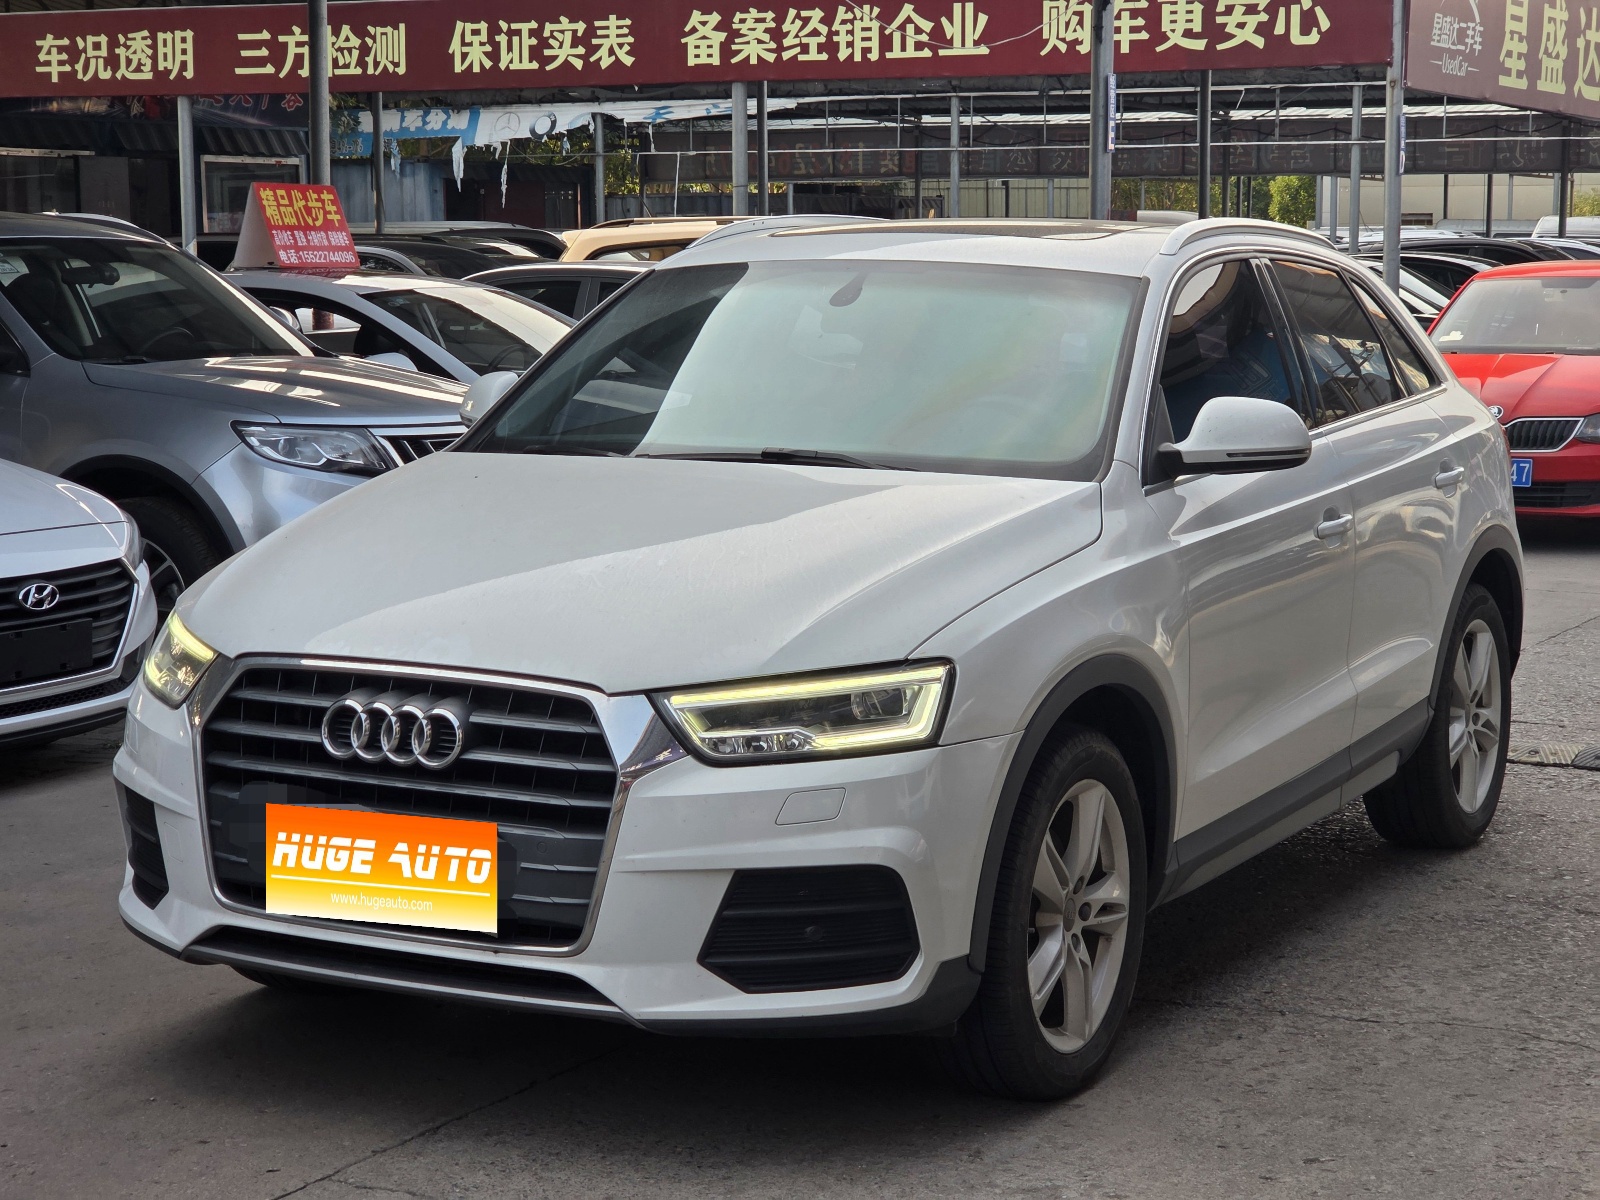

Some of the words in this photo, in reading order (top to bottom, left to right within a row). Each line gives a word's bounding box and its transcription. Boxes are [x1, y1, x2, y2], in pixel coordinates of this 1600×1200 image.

[35, 29, 195, 83] 车况透明
[234, 23, 407, 79] 三方检测
[448, 14, 636, 73] 保证实表
[680, 2, 991, 66] 备案经销企业
[1040, 0, 1331, 56] 购车更安心
[1430, 13, 1485, 57] 星盛达二手车
[259, 187, 342, 227] 精品代步车
